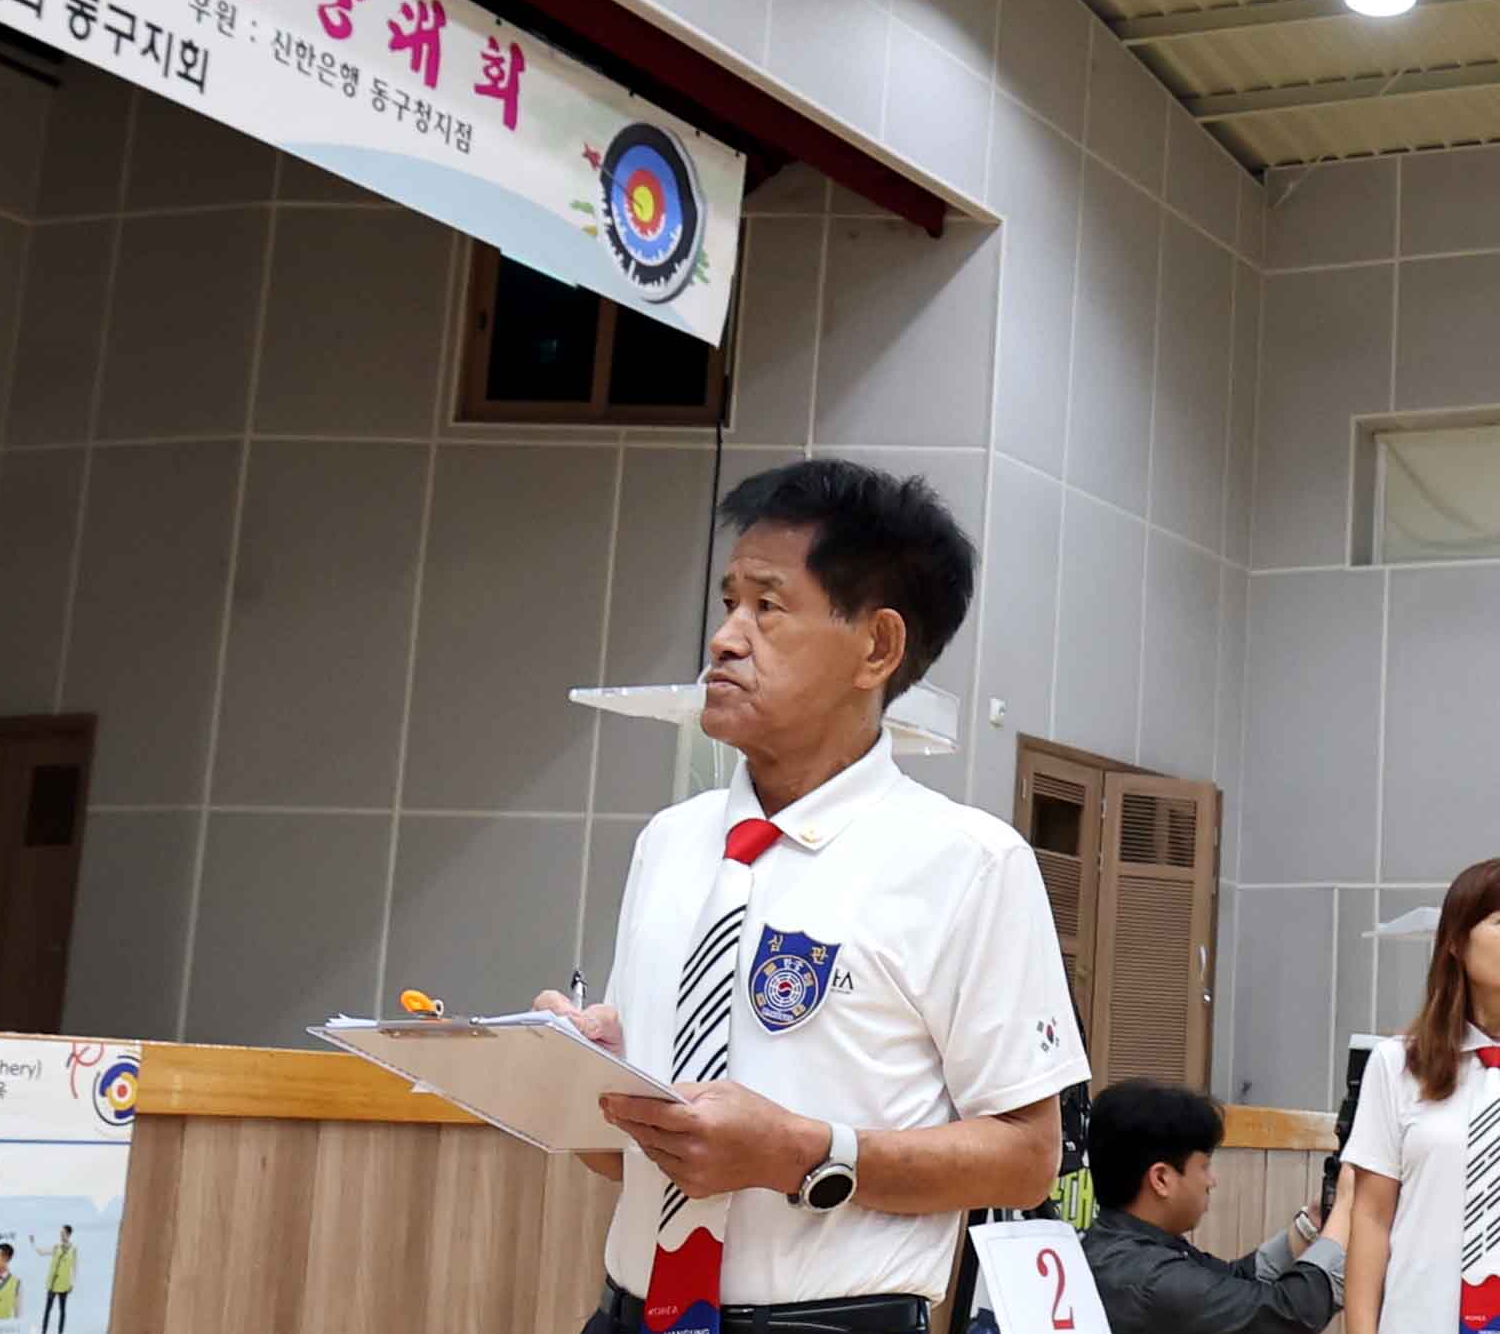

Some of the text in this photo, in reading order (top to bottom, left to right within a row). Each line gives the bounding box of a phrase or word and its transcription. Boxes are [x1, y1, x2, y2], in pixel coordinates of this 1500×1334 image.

[270, 30, 362, 99] 신한은행
[370, 78, 475, 156] 동구청지점
[1037, 1247, 1075, 1330] 2
